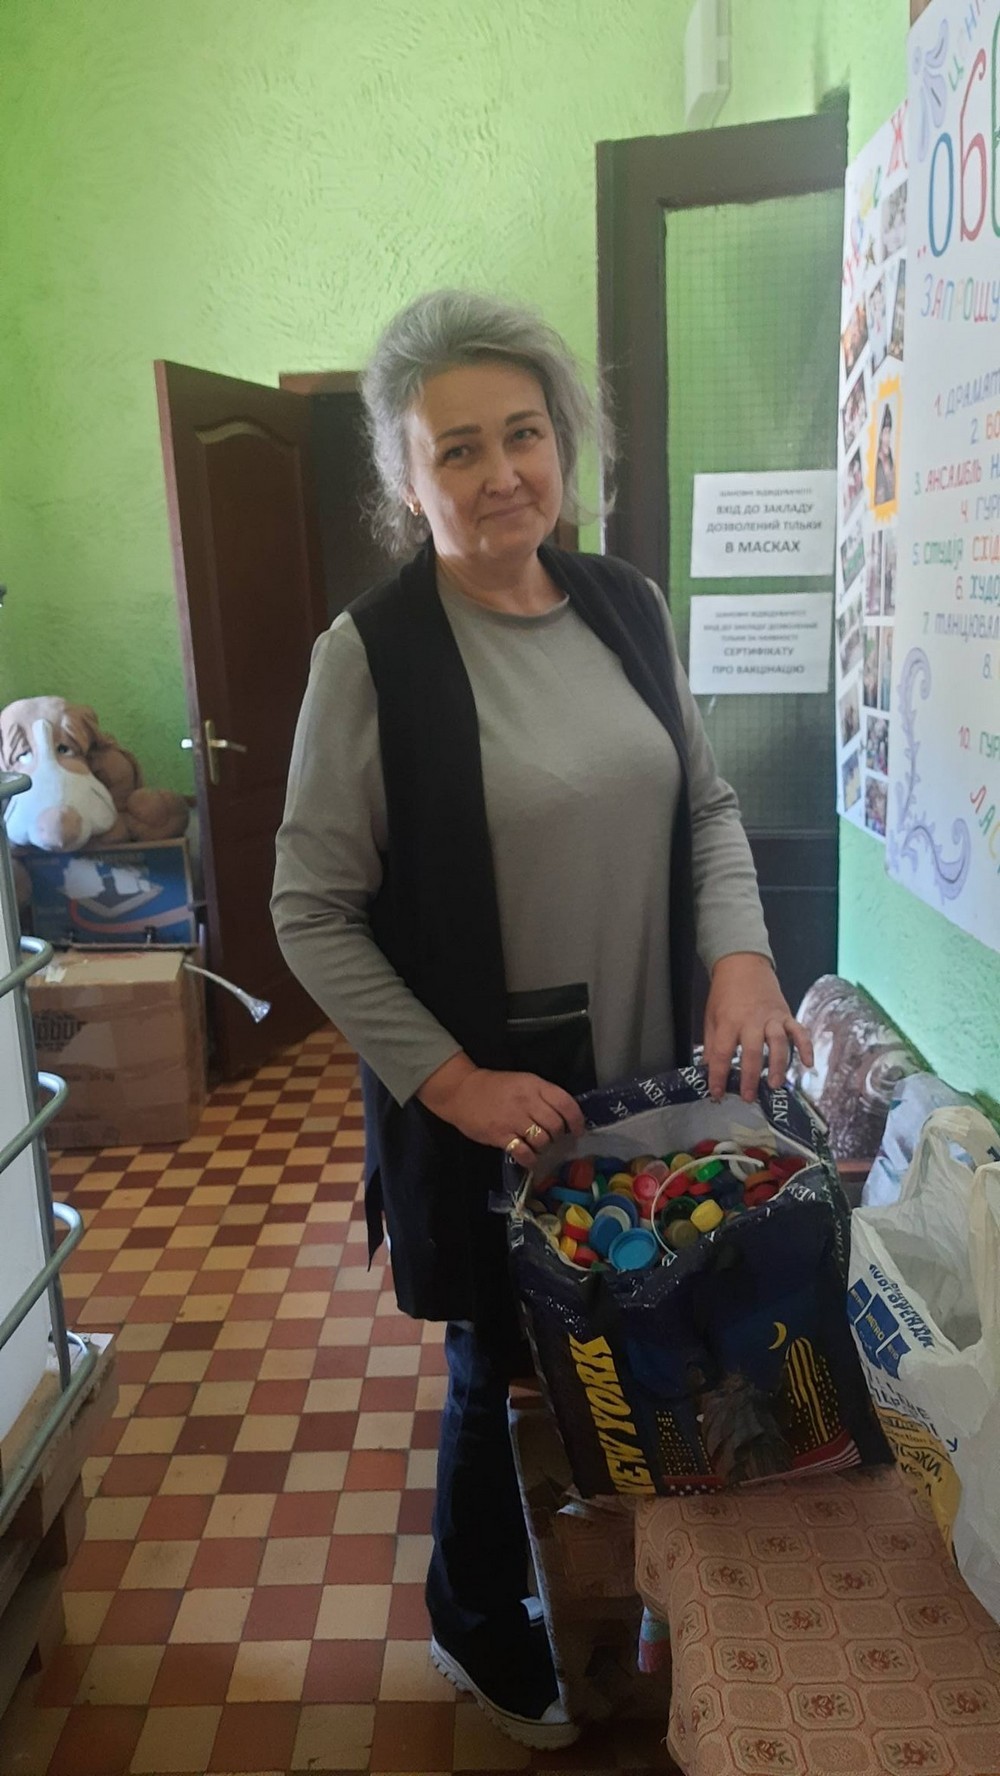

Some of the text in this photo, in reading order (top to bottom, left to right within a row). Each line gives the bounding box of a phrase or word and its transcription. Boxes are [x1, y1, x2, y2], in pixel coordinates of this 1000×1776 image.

[716, 503, 814, 516] ВХІД ДО ЗАКЛАДУ
[706, 519, 822, 533] ДОЗВОЛЕНИЙ ТІЛЬКИ
[725, 540, 801, 554] В МАСКАХ
[724, 647, 795, 657] СЕРТИФІКАТУ
[712, 665, 733, 675] ПРО
[865, 1312, 885, 1341] METRO
